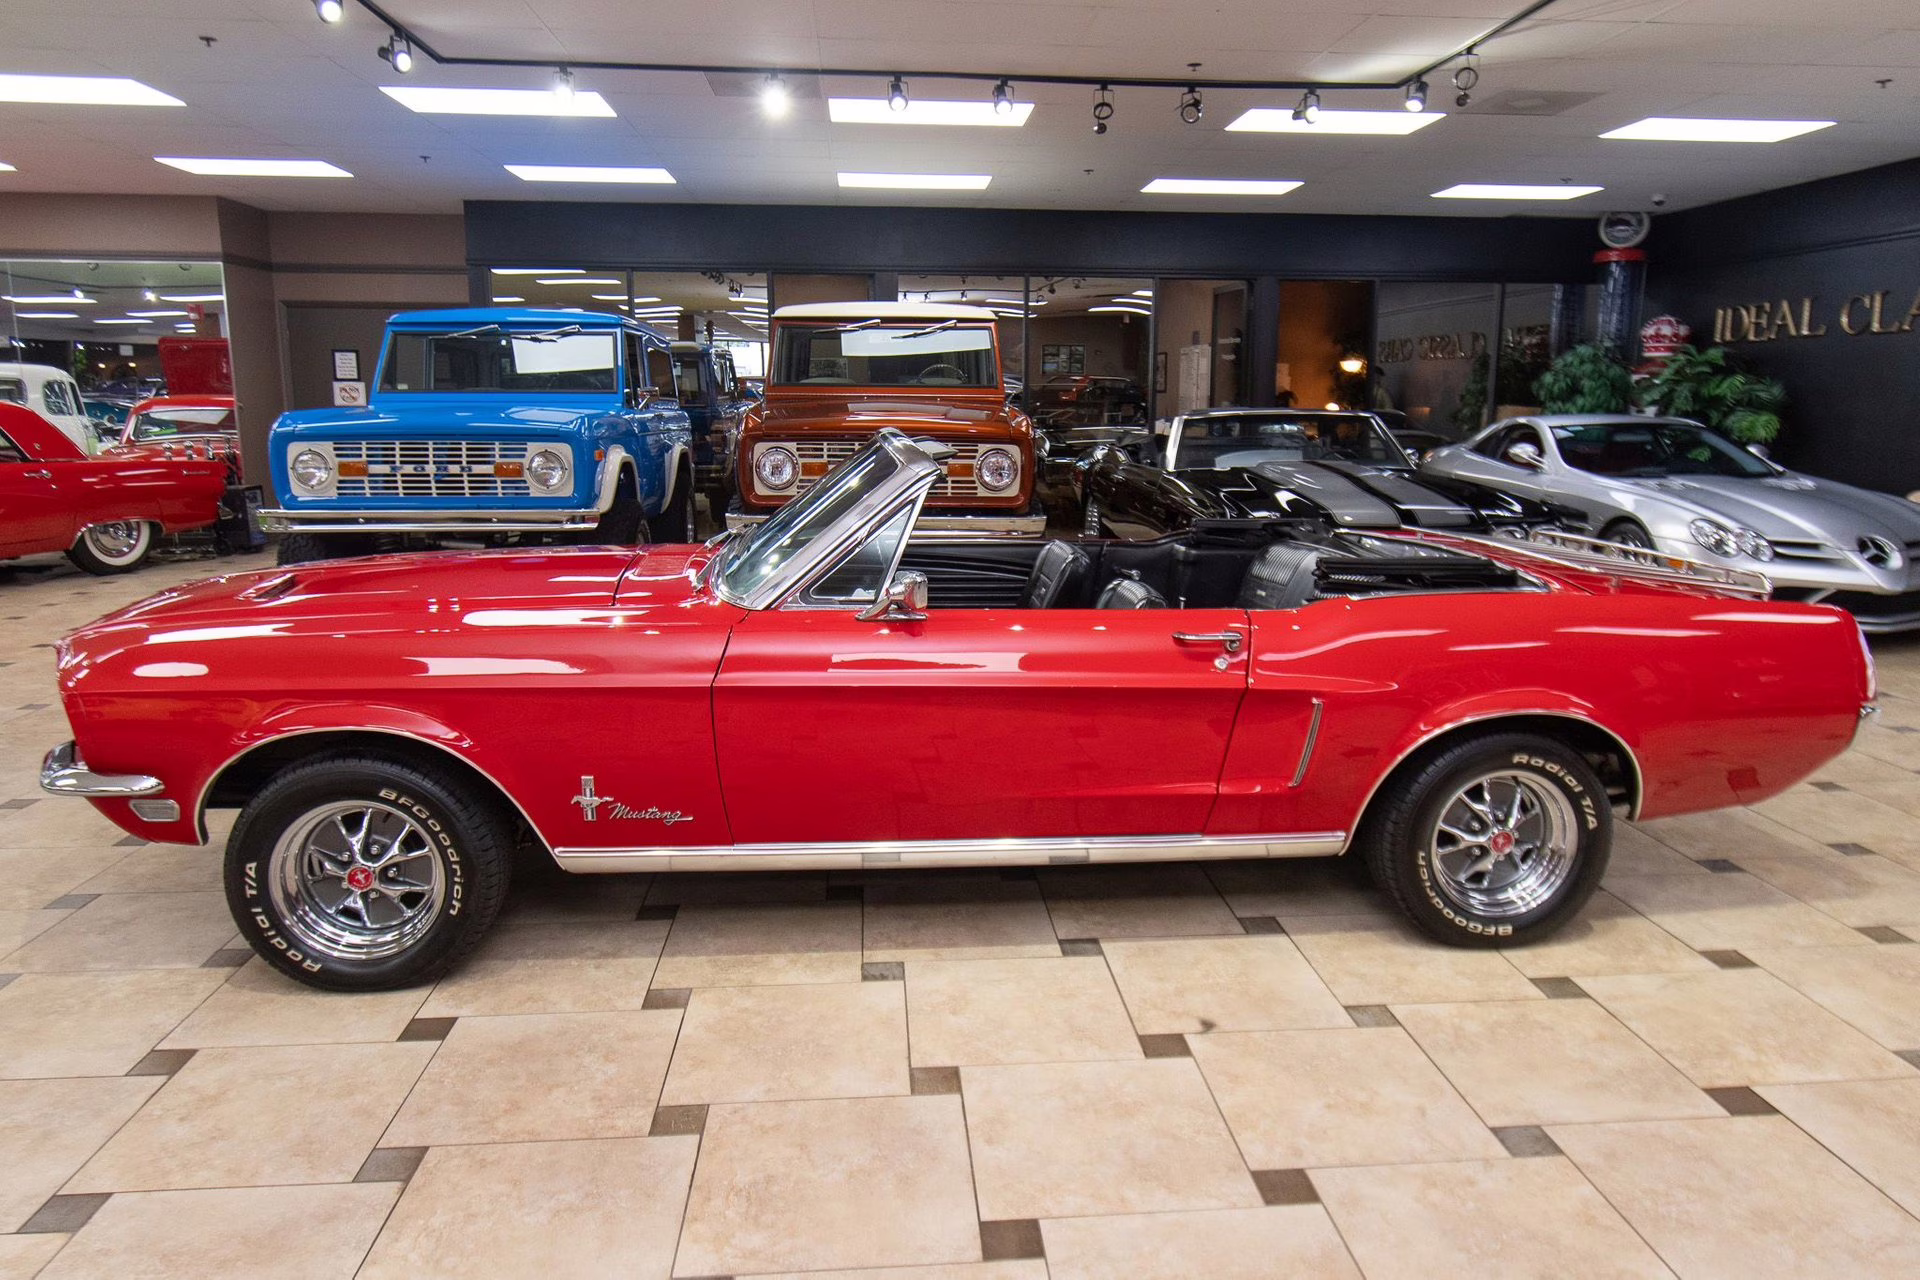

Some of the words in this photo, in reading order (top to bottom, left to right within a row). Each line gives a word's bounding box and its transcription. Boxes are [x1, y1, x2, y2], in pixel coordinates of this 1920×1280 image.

[1713, 296, 1827, 343] IDEAL
[389, 464, 473, 473] FORD
[608, 802, 694, 826] Mustang
[1512, 753, 1584, 793] Radial
[1580, 797, 1599, 830] T/A
[243, 860, 259, 899] T/A
[378, 787, 464, 917] BFGoodrich
[1416, 851, 1514, 937] BFGoodrich
[250, 906, 323, 974] Radial
